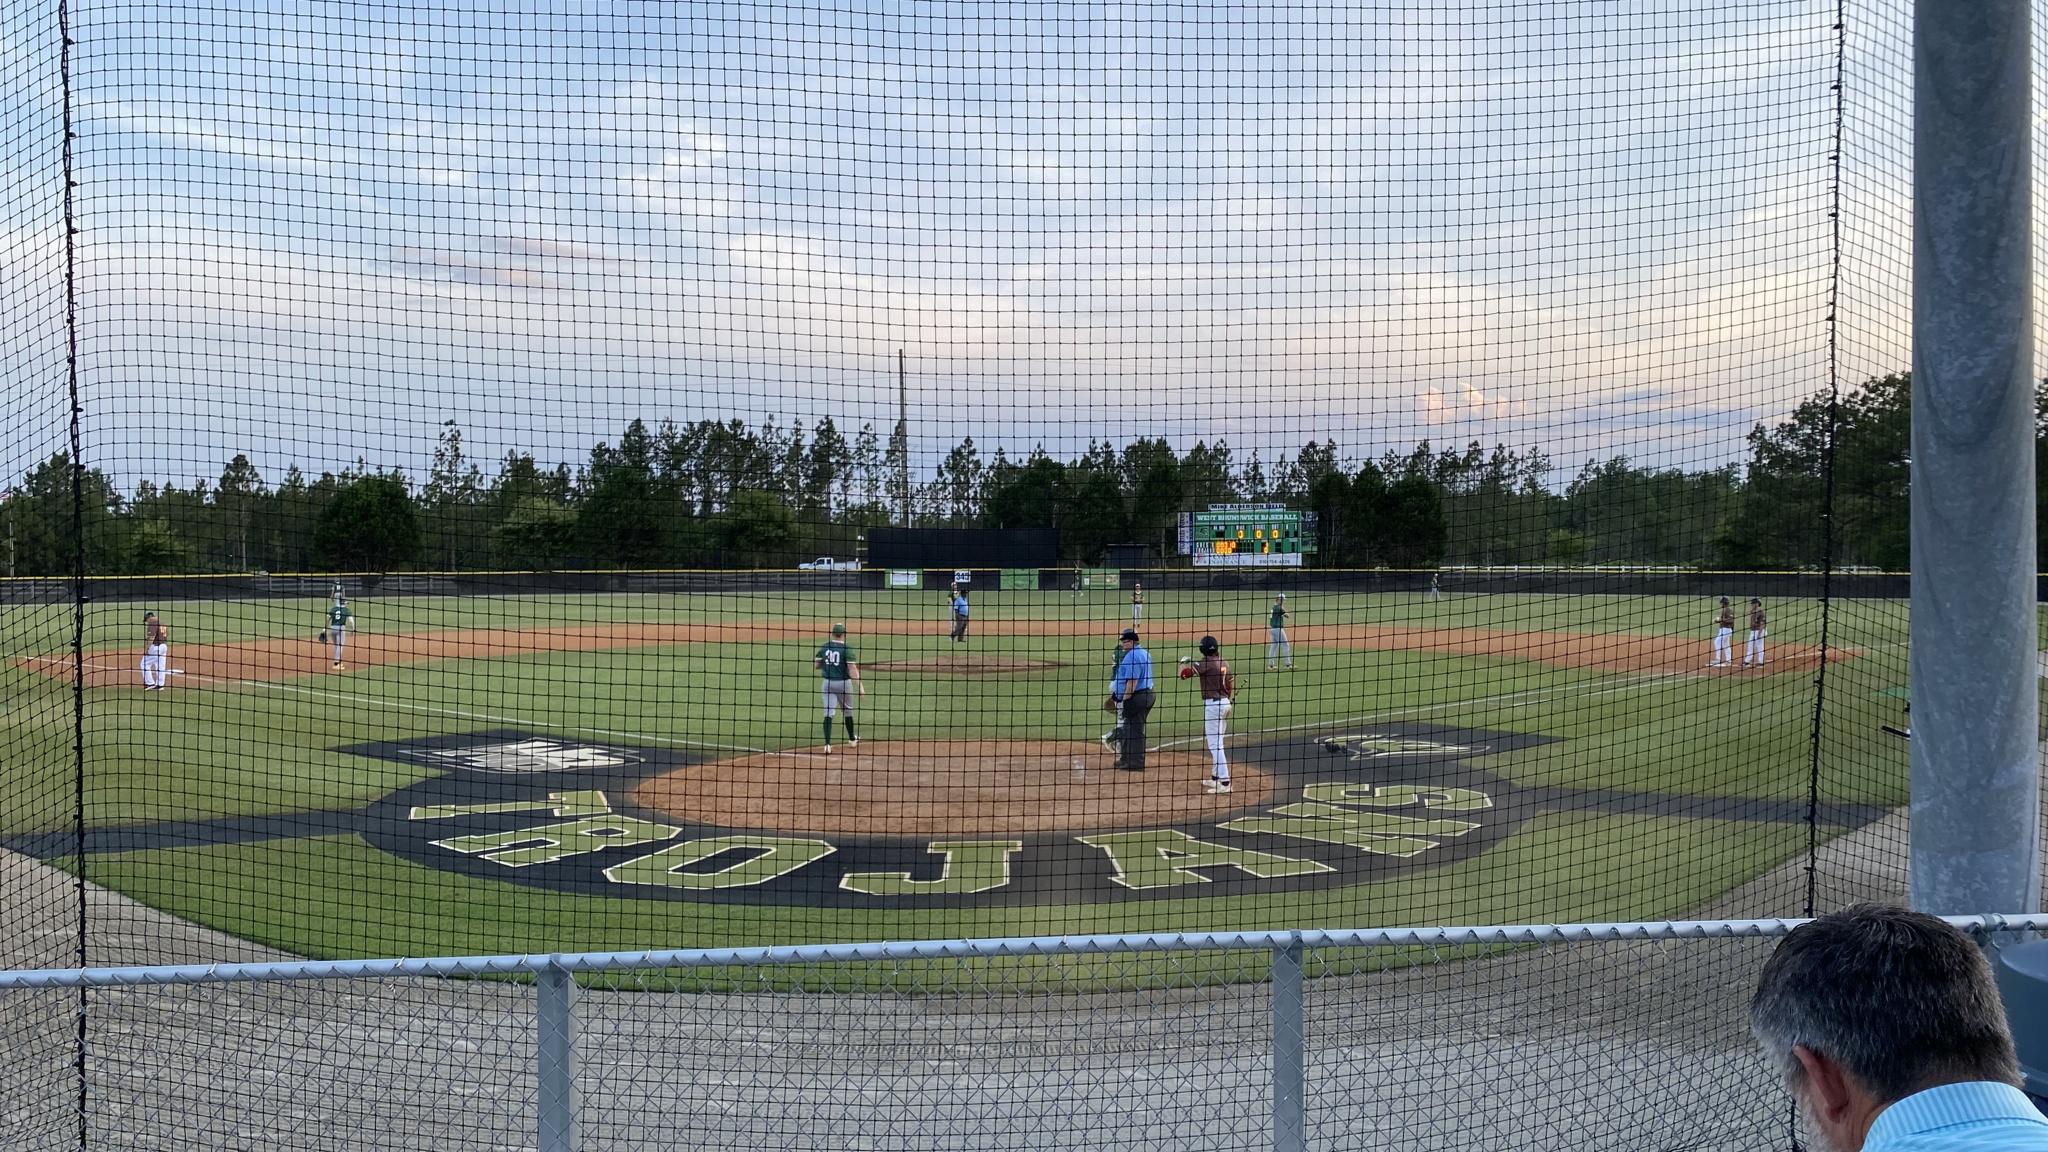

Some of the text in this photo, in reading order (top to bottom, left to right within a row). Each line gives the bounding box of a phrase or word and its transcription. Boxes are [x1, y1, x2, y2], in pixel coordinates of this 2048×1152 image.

[1237, 529, 1244, 539] 0
[1255, 529, 1262, 539] 0
[1272, 529, 1279, 539] 0
[955, 572, 970, 580] 345
[408, 782, 1493, 896] TROJANS
